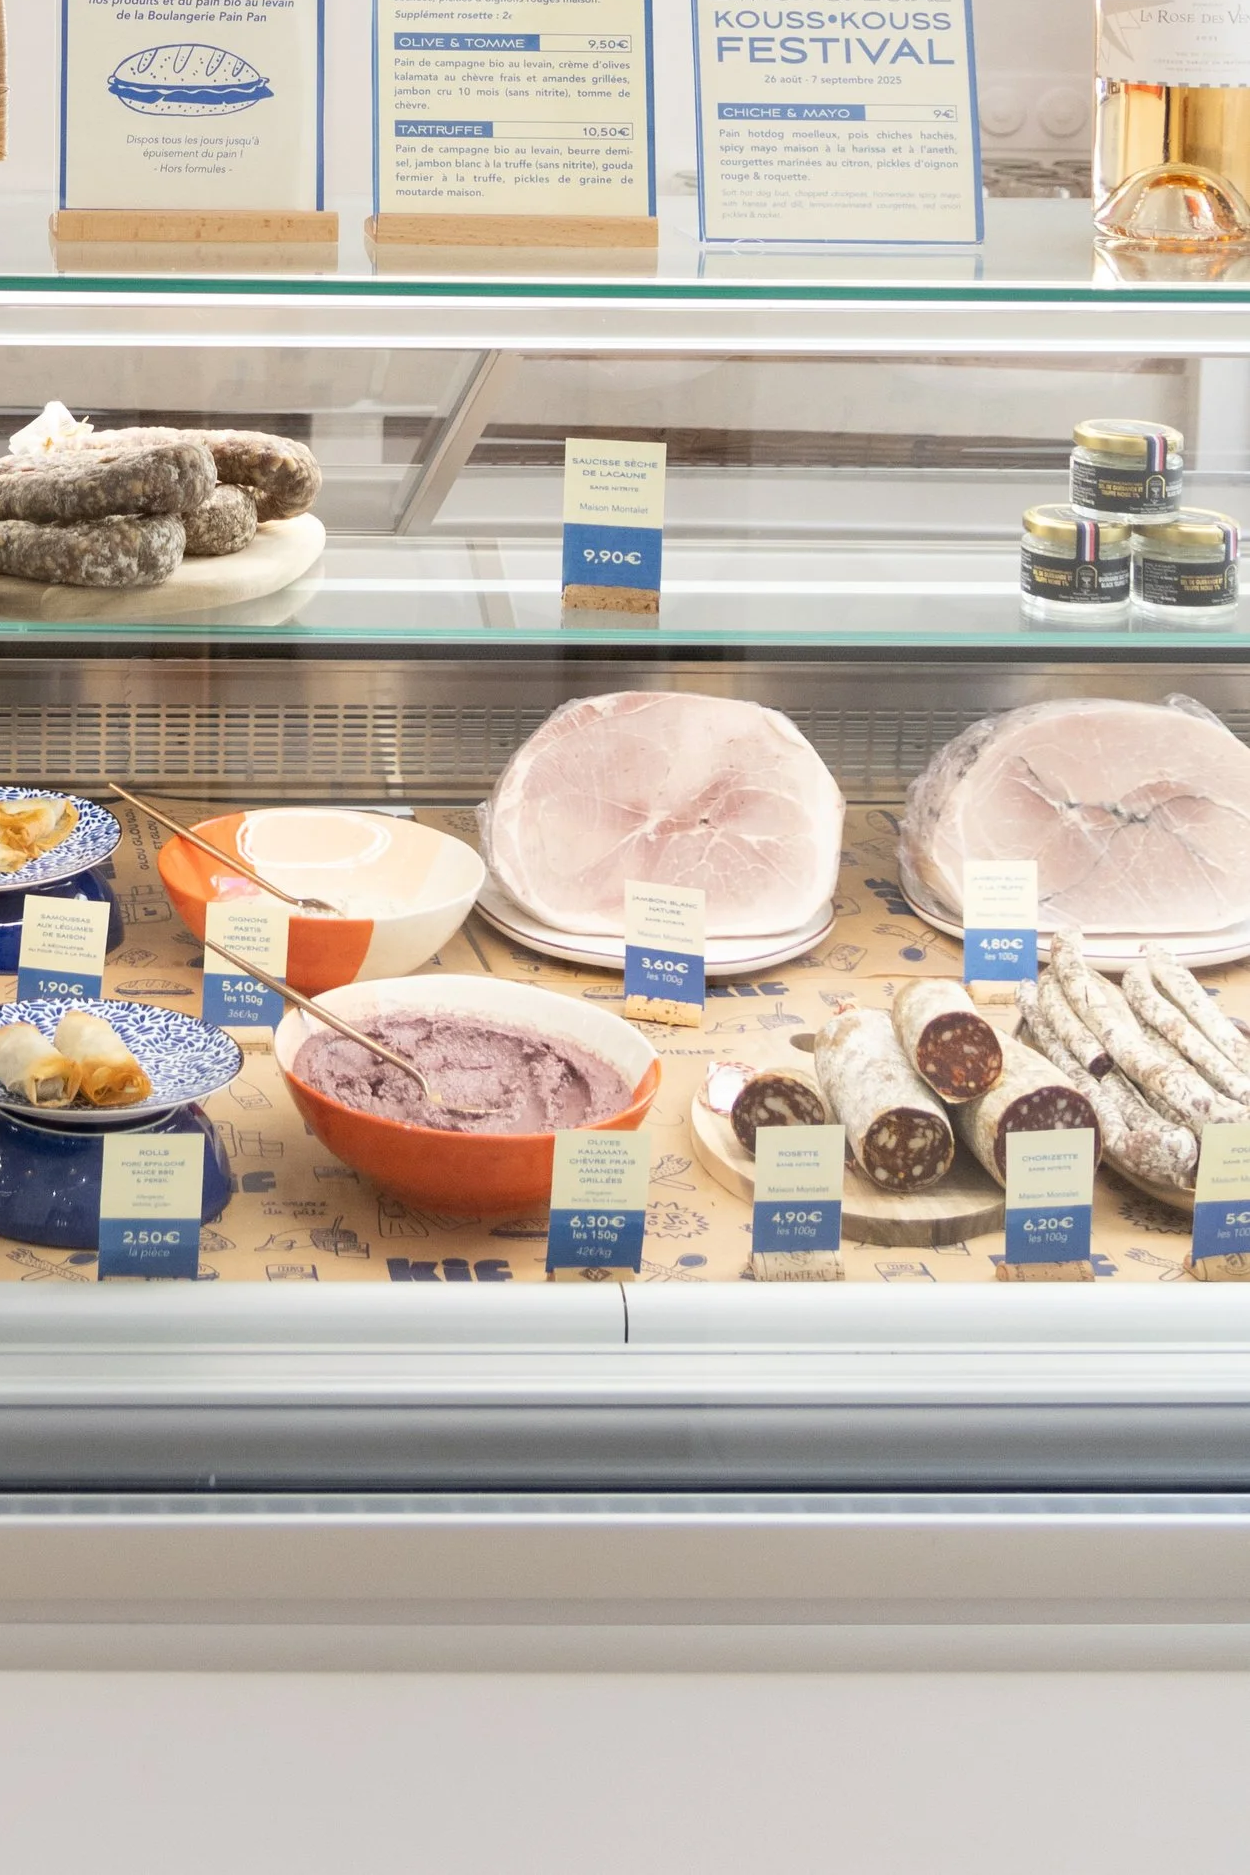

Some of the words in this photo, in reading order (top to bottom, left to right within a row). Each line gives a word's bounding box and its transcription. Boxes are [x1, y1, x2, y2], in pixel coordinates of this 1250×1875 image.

[245, 0, 258, 7] au
[116, 9, 131, 20] de
[134, 10, 144, 20] la
[148, 10, 215, 23] Boulangerie
[219, 11, 243, 22] Pain
[246, 12, 267, 22] Pan
[399, 37, 444, 47] OLIVE
[450, 38, 460, 48] &
[464, 38, 525, 48] TOMME
[588, 39, 628, 50] 9,50€
[717, 36, 955, 65] FESTIVAL
[764, 74, 777, 84] 26
[780, 75, 802, 84] août
[820, 75, 874, 85] septembre
[877, 75, 902, 85] 2025
[723, 107, 781, 117] CHICHE
[803, 109, 850, 118] MAYO
[933, 109, 954, 119] 9€
[398, 125, 483, 136] TARTRUFFE
[583, 127, 629, 137] 10,50€
[126, 134, 159, 146] Dispos
[162, 136, 182, 144] tous
[184, 135, 198, 144] les
[199, 136, 223, 147] jours
[225, 136, 259, 148] jusqu'à
[142, 148, 199, 160] épuisement
[201, 149, 214, 158] du
[216, 147, 237, 161] pain
[572, 458, 620, 466] SAUCISSE
[624, 458, 658, 469] SÈCHE
[583, 470, 596, 478] DE
[599, 470, 646, 479] LACAUNE
[580, 503, 608, 512] Maison
[611, 505, 648, 514] Montalet
[584, 549, 641, 565] 9,90€
[980, 938, 1023, 949] 4,80€
[642, 958, 688, 973] 3,60€
[646, 972, 659, 981] les
[662, 975, 682, 985] 100g
[39, 981, 83, 996] 1,90€
[222, 981, 268, 994] 5,40€
[224, 993, 237, 1002] les
[240, 994, 263, 1006] 150g
[569, 1157, 606, 1165] CHÈVRE
[1022, 1153, 1078, 1162] CHORIZETTE
[579, 1176, 622, 1184] GRILLÉES
[569, 1216, 626, 1229] 6,30€
[772, 1211, 822, 1224] 4,90€
[1023, 1217, 1073, 1231] 6,20€
[573, 1230, 587, 1240] les
[591, 1230, 618, 1242] 150g
[777, 1226, 790, 1235] les
[793, 1226, 816, 1237] 100g
[123, 1231, 180, 1245] 2,50€
[1029, 1233, 1041, 1243] les
[1045, 1233, 1068, 1243] 100g
[129, 1248, 138, 1257] la
[140, 1247, 170, 1259] pièce
